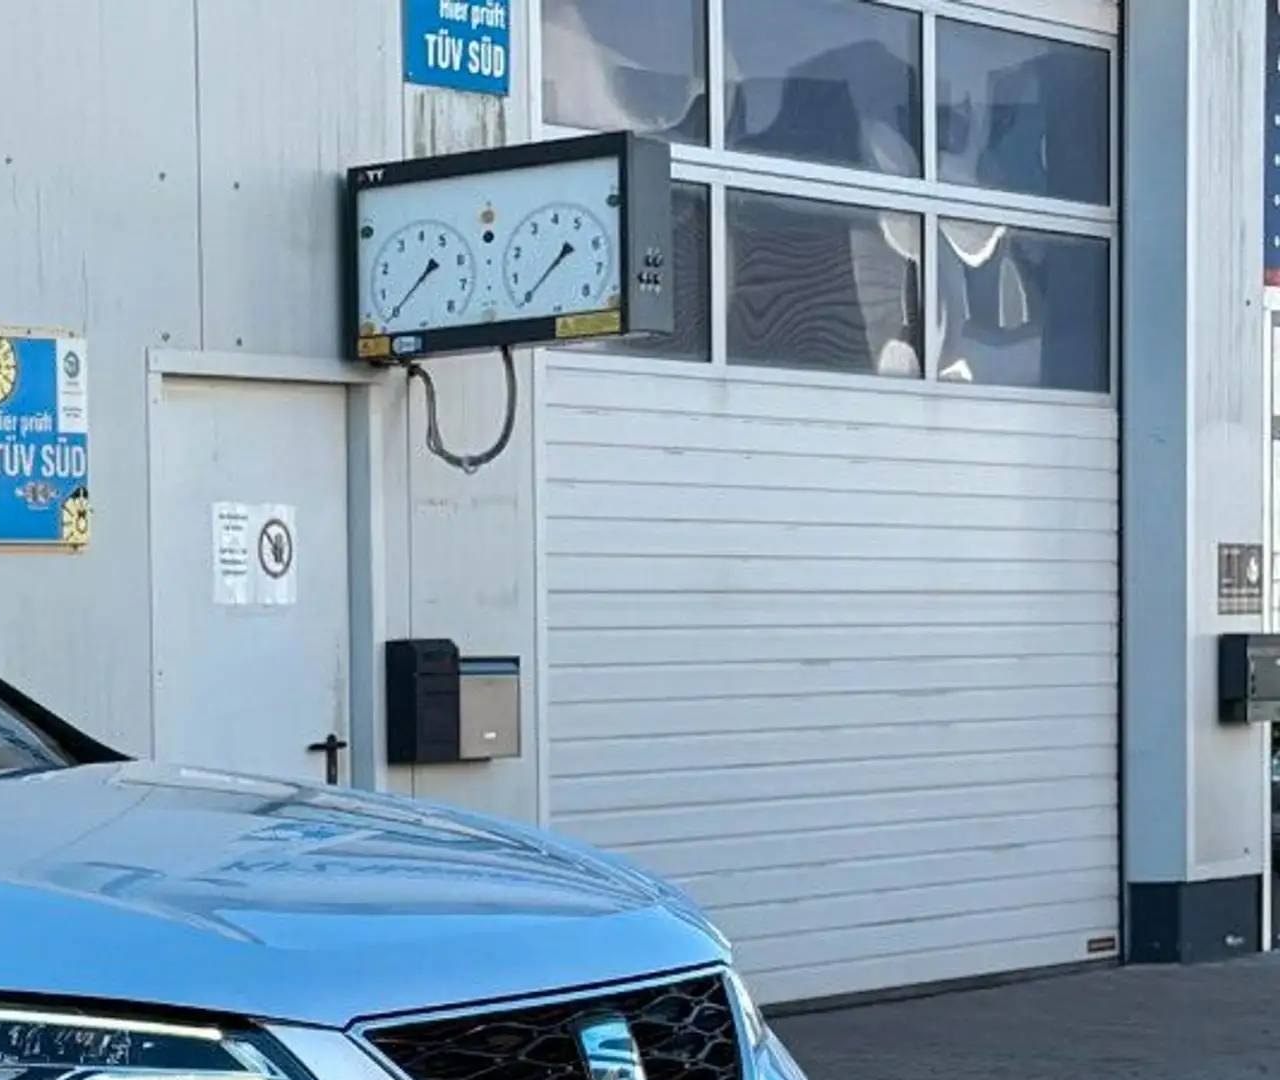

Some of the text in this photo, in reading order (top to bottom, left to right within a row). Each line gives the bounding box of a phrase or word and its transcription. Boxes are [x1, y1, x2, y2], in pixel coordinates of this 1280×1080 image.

[424, 28, 505, 78] TÜV SÜD
[550, 213, 559, 225] 4
[573, 216, 582, 230] 5
[41, 436, 86, 477] SÜD
